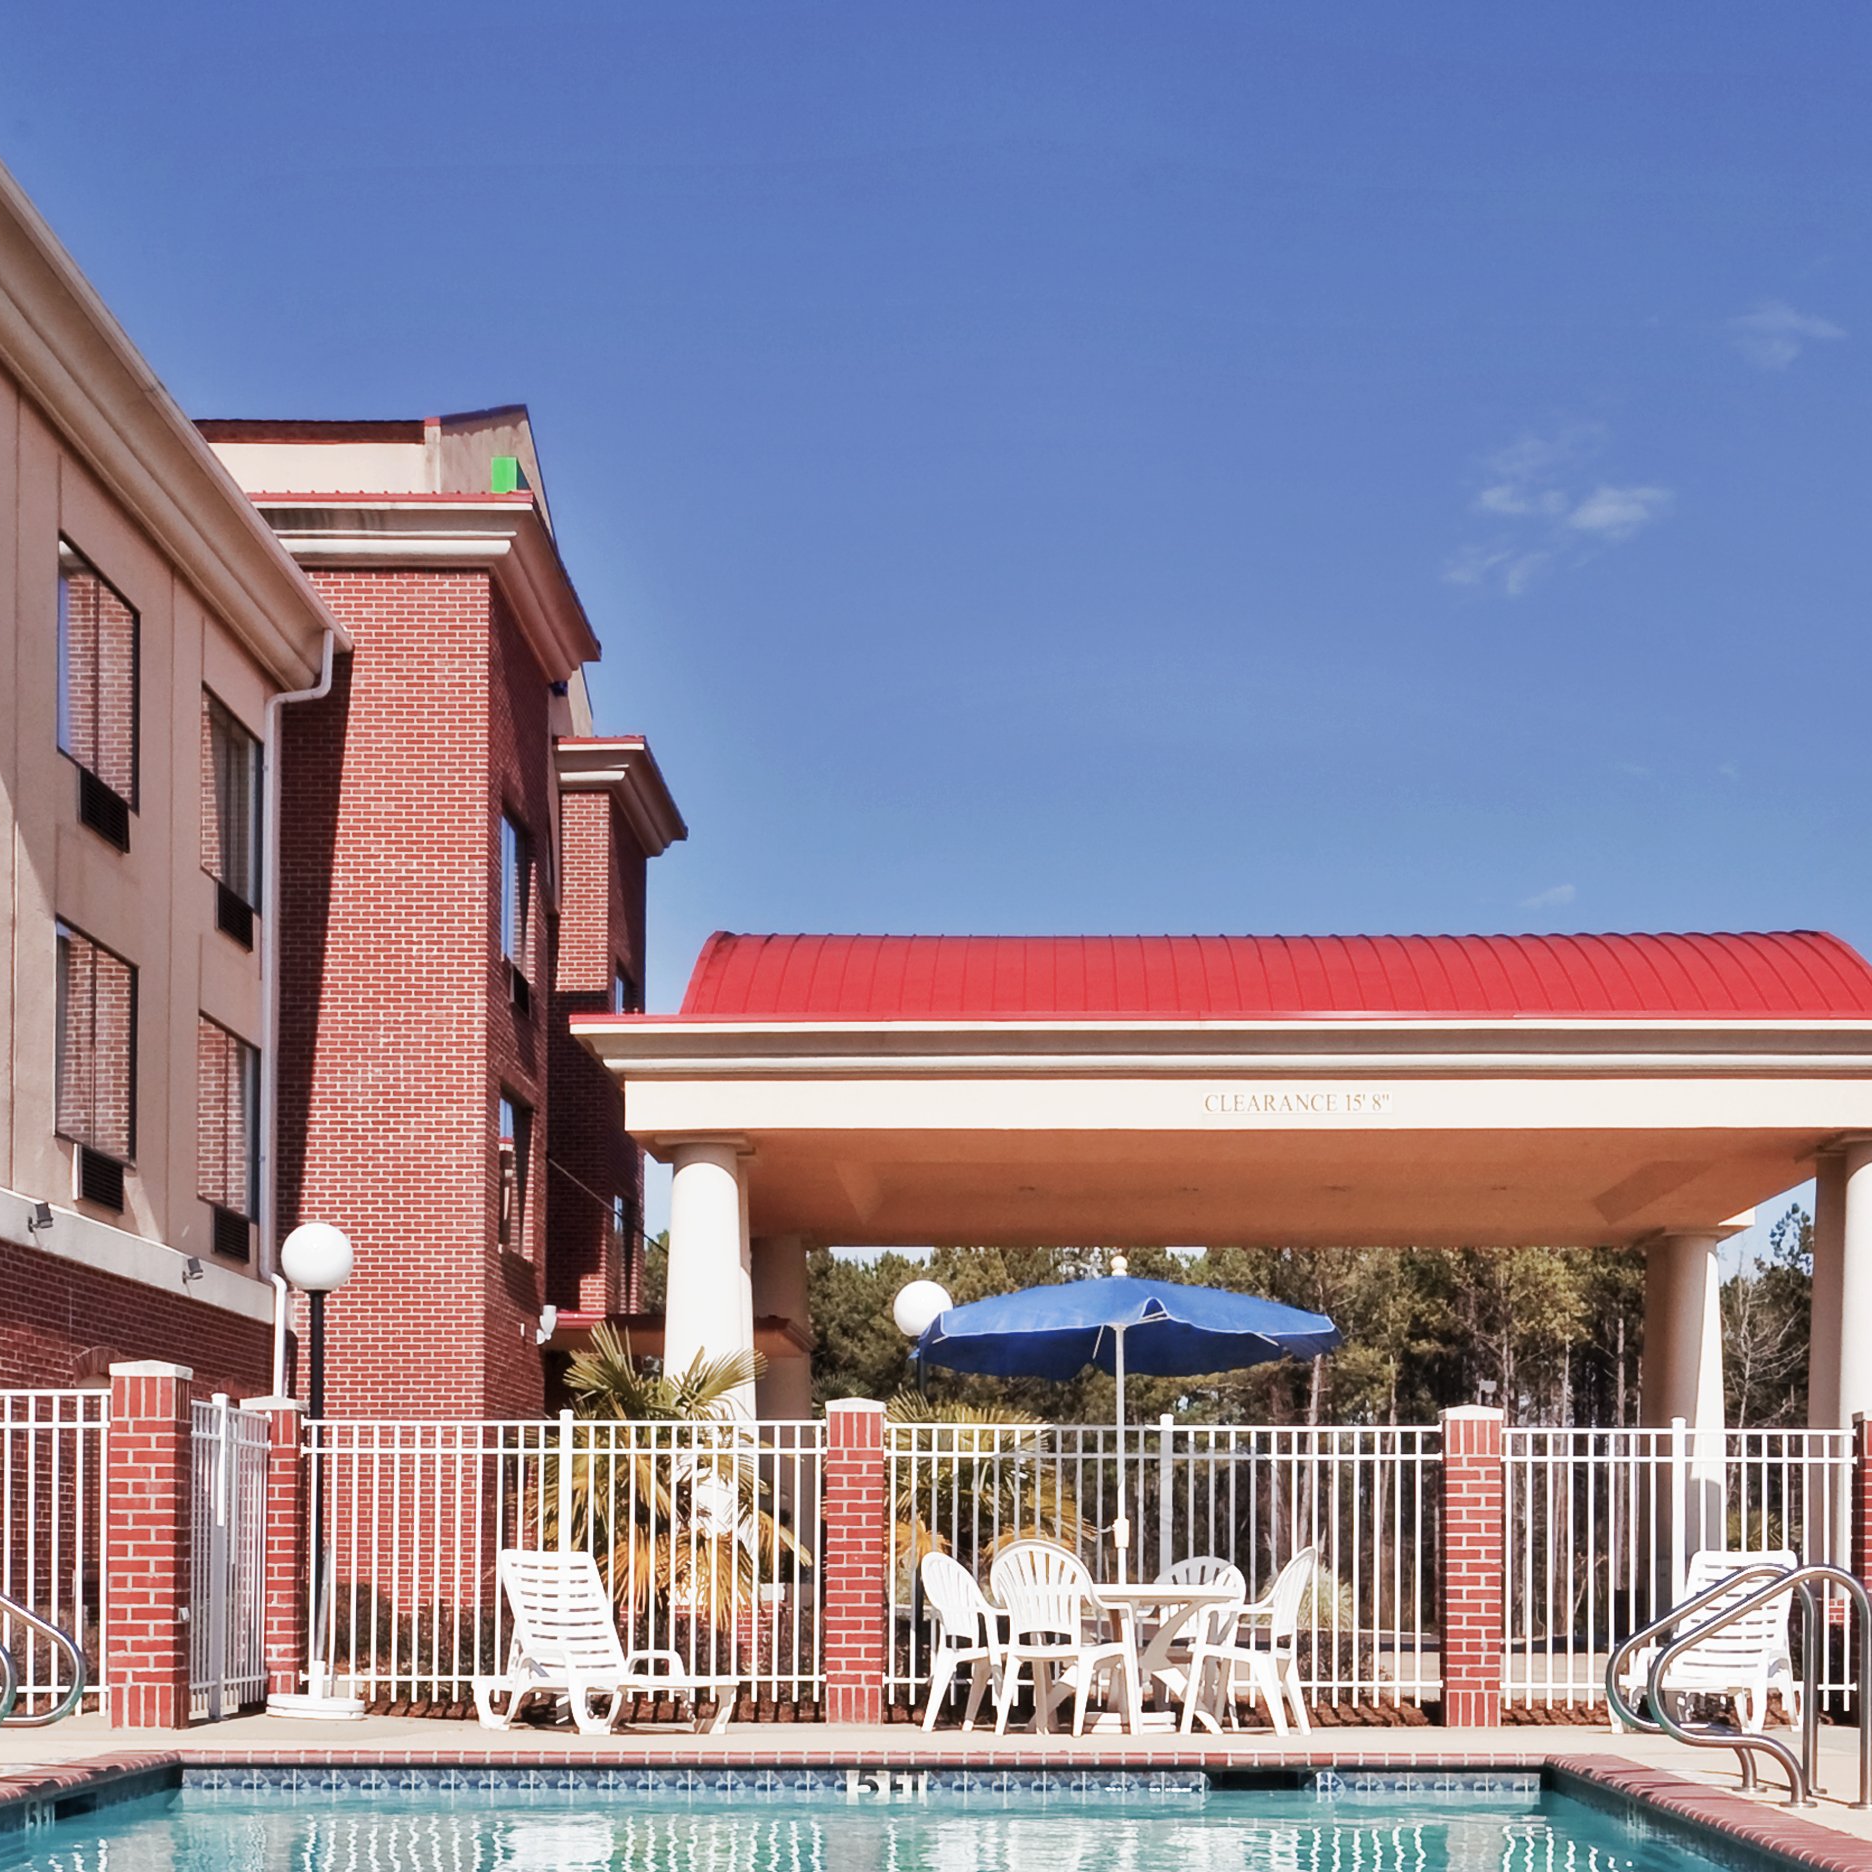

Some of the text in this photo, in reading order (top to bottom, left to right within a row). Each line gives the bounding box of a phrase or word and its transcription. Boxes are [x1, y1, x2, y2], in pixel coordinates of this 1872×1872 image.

[1204, 1093, 1390, 1112] CLEARANCE 15' 8"
